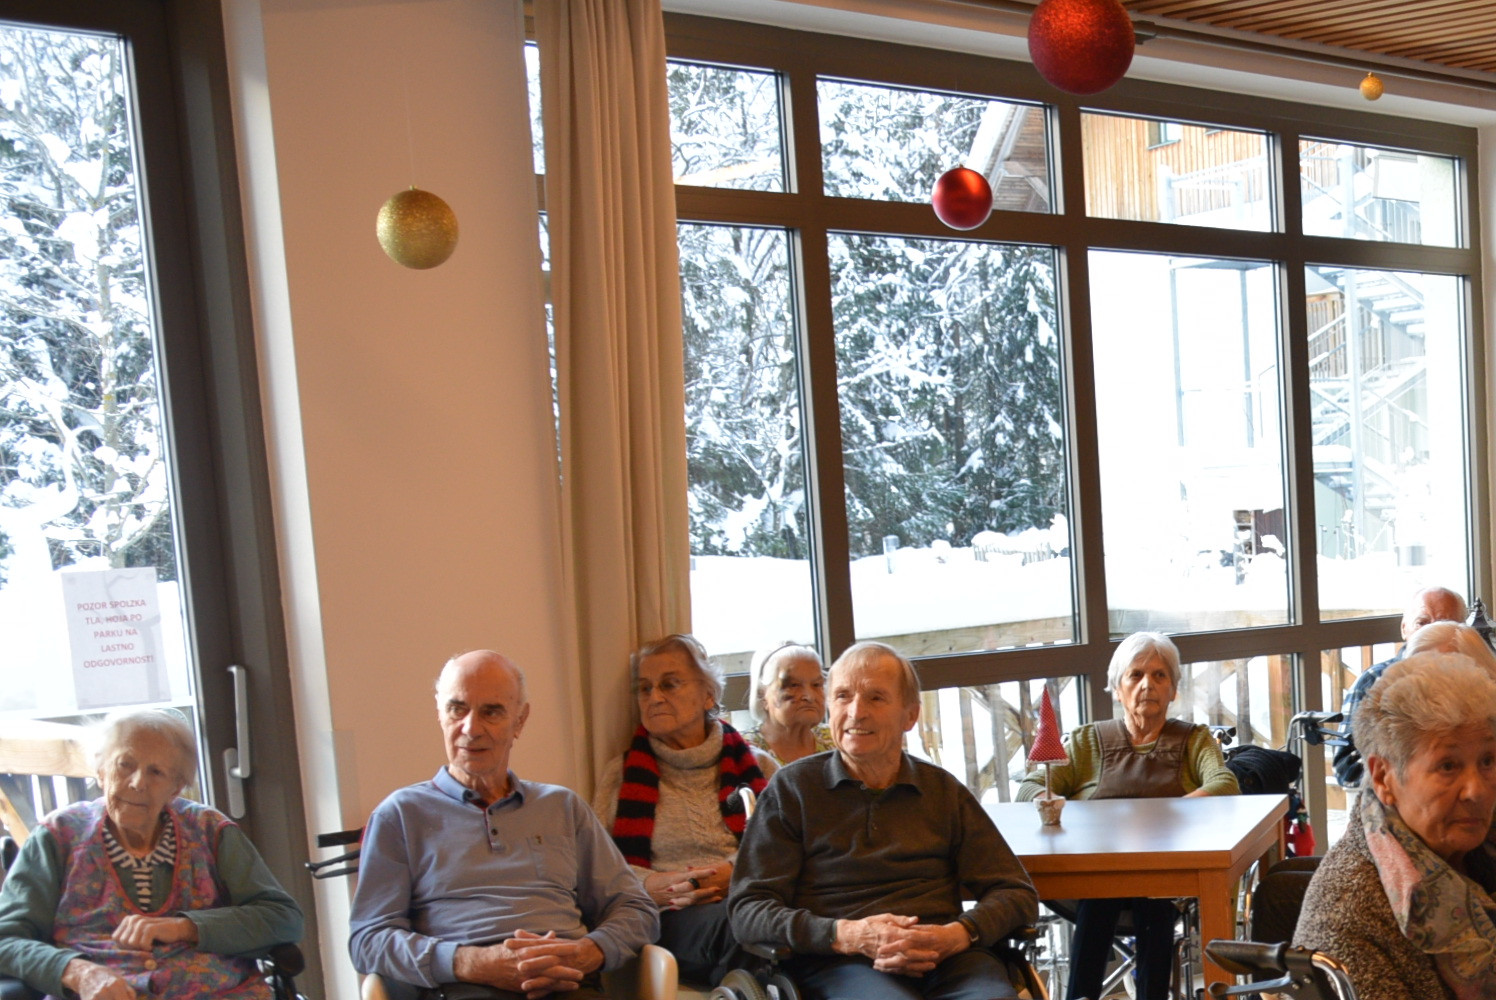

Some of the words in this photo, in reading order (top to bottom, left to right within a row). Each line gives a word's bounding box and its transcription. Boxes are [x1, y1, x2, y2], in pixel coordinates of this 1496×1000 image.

[77, 602, 107, 611] POZOR
[109, 600, 146, 609] SPOLZKA
[105, 615, 128, 623] HOJA
[130, 613, 142, 621] PO
[94, 630, 123, 638] PARKU
[125, 628, 138, 636] NA
[101, 643, 134, 652] LASTNO
